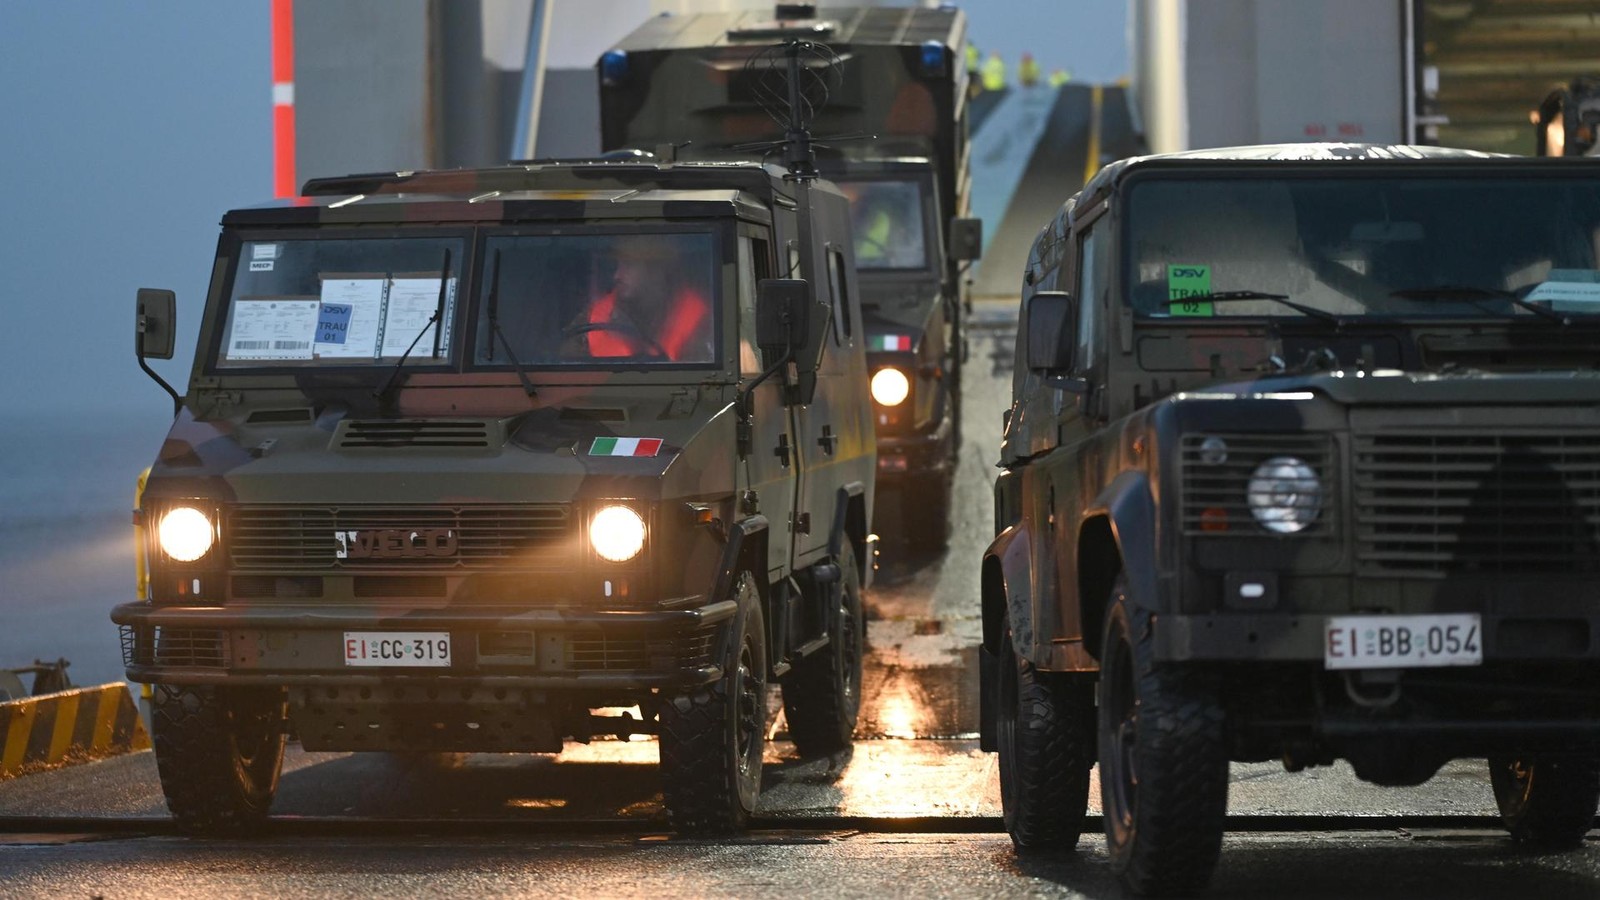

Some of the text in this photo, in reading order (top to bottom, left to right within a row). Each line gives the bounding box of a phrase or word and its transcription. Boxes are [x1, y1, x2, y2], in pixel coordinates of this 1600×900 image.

[1173, 268, 1206, 278] DSV
[324, 306, 348, 314] DSV
[1182, 302, 1200, 313] 02
[319, 321, 347, 331] TRAU
[324, 333, 336, 341] 01
[335, 530, 458, 558] IVECO
[1328, 625, 1478, 657] EI BB 054
[346, 639, 449, 660] EI CG 319
